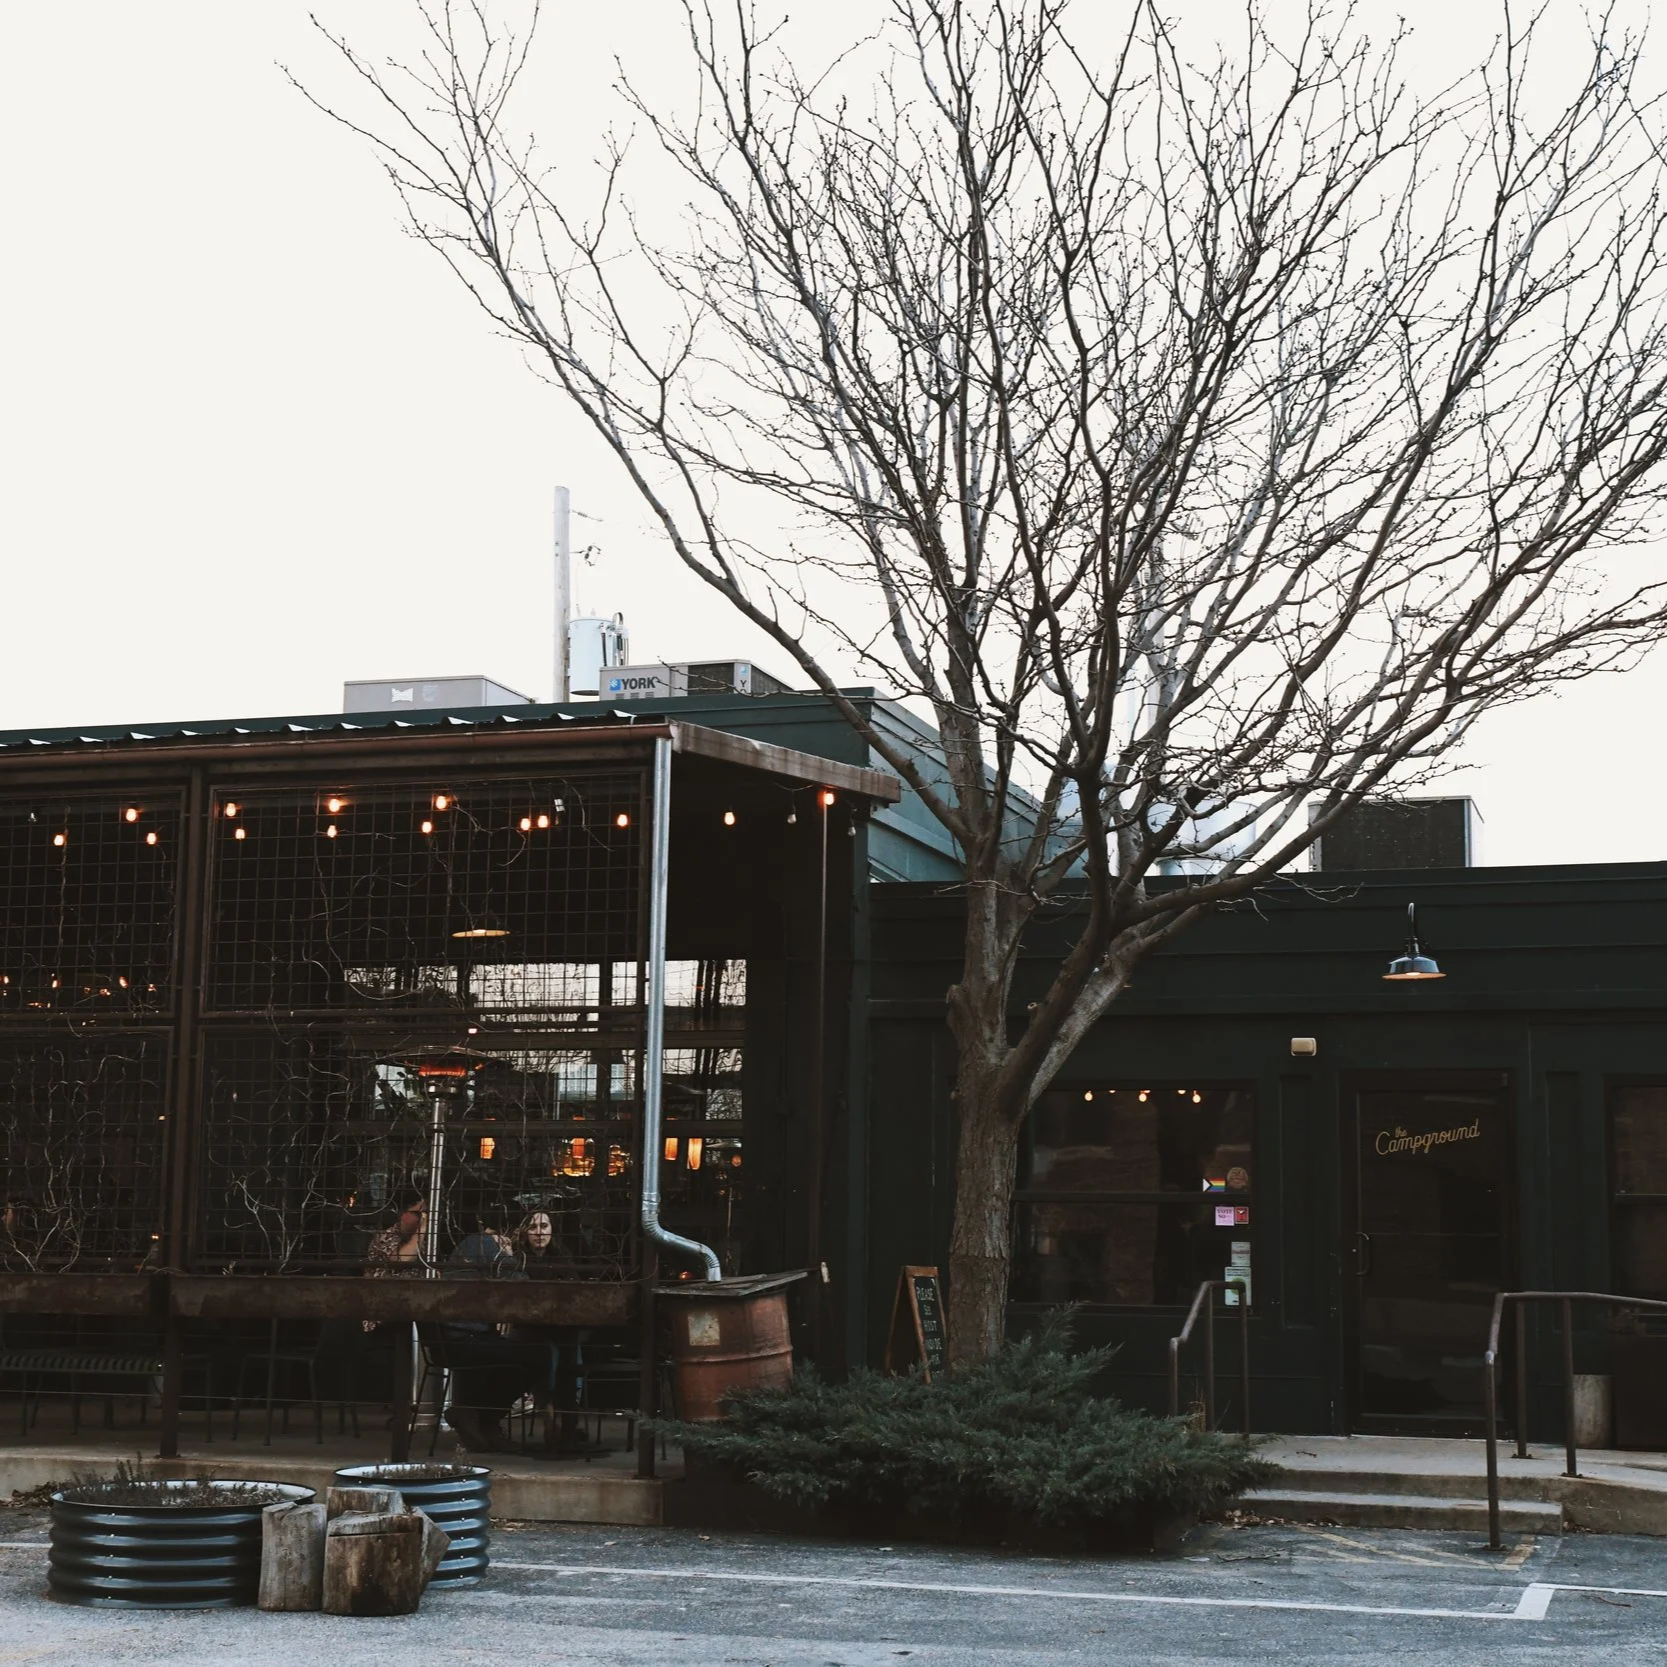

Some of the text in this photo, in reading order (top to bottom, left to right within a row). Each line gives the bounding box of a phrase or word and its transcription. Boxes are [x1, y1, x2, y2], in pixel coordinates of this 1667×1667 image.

[621, 677, 656, 690] YORK
[1375, 1118, 1480, 1155] Campground
[1395, 1126, 1408, 1138] the
